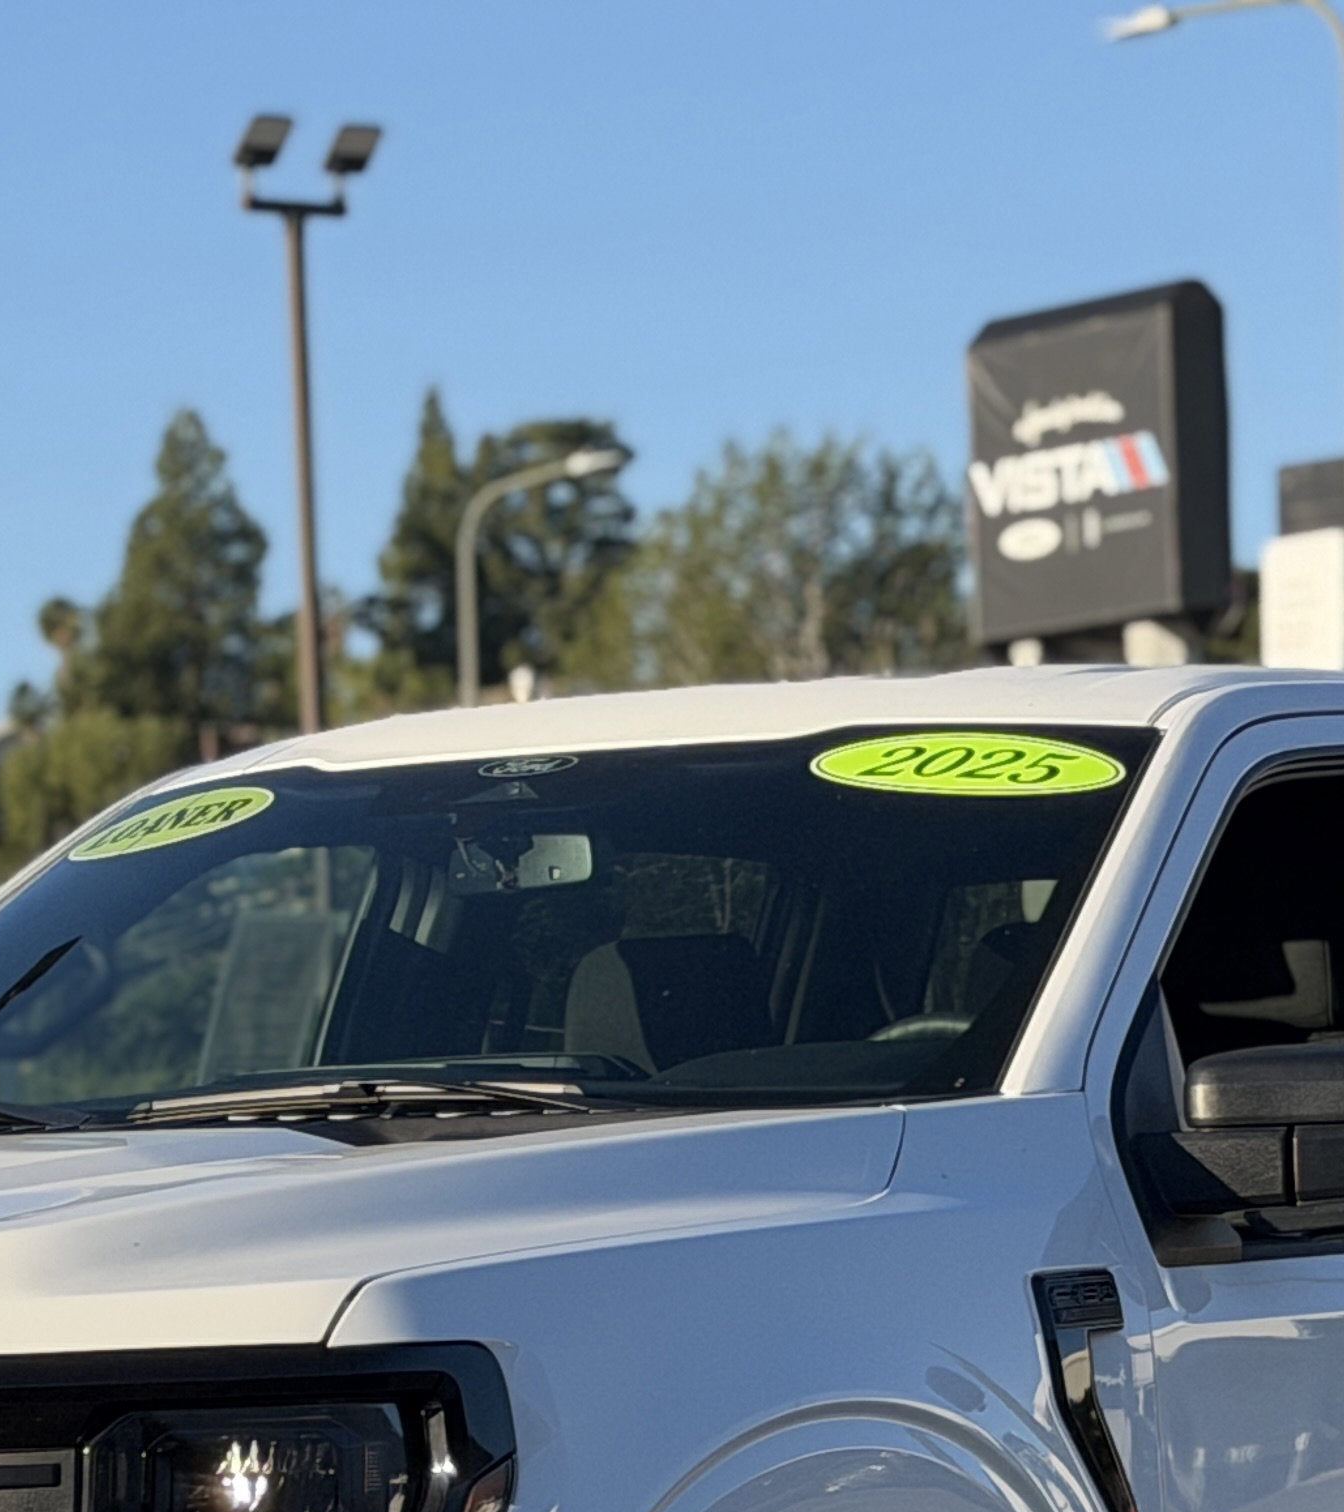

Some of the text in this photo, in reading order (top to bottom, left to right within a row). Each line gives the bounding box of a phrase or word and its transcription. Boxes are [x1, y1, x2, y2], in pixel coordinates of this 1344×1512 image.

[968, 440, 1120, 517] VISTA
[493, 758, 562, 774] Ford
[856, 746, 1080, 784] 2025
[87, 797, 253, 850] LOANER
